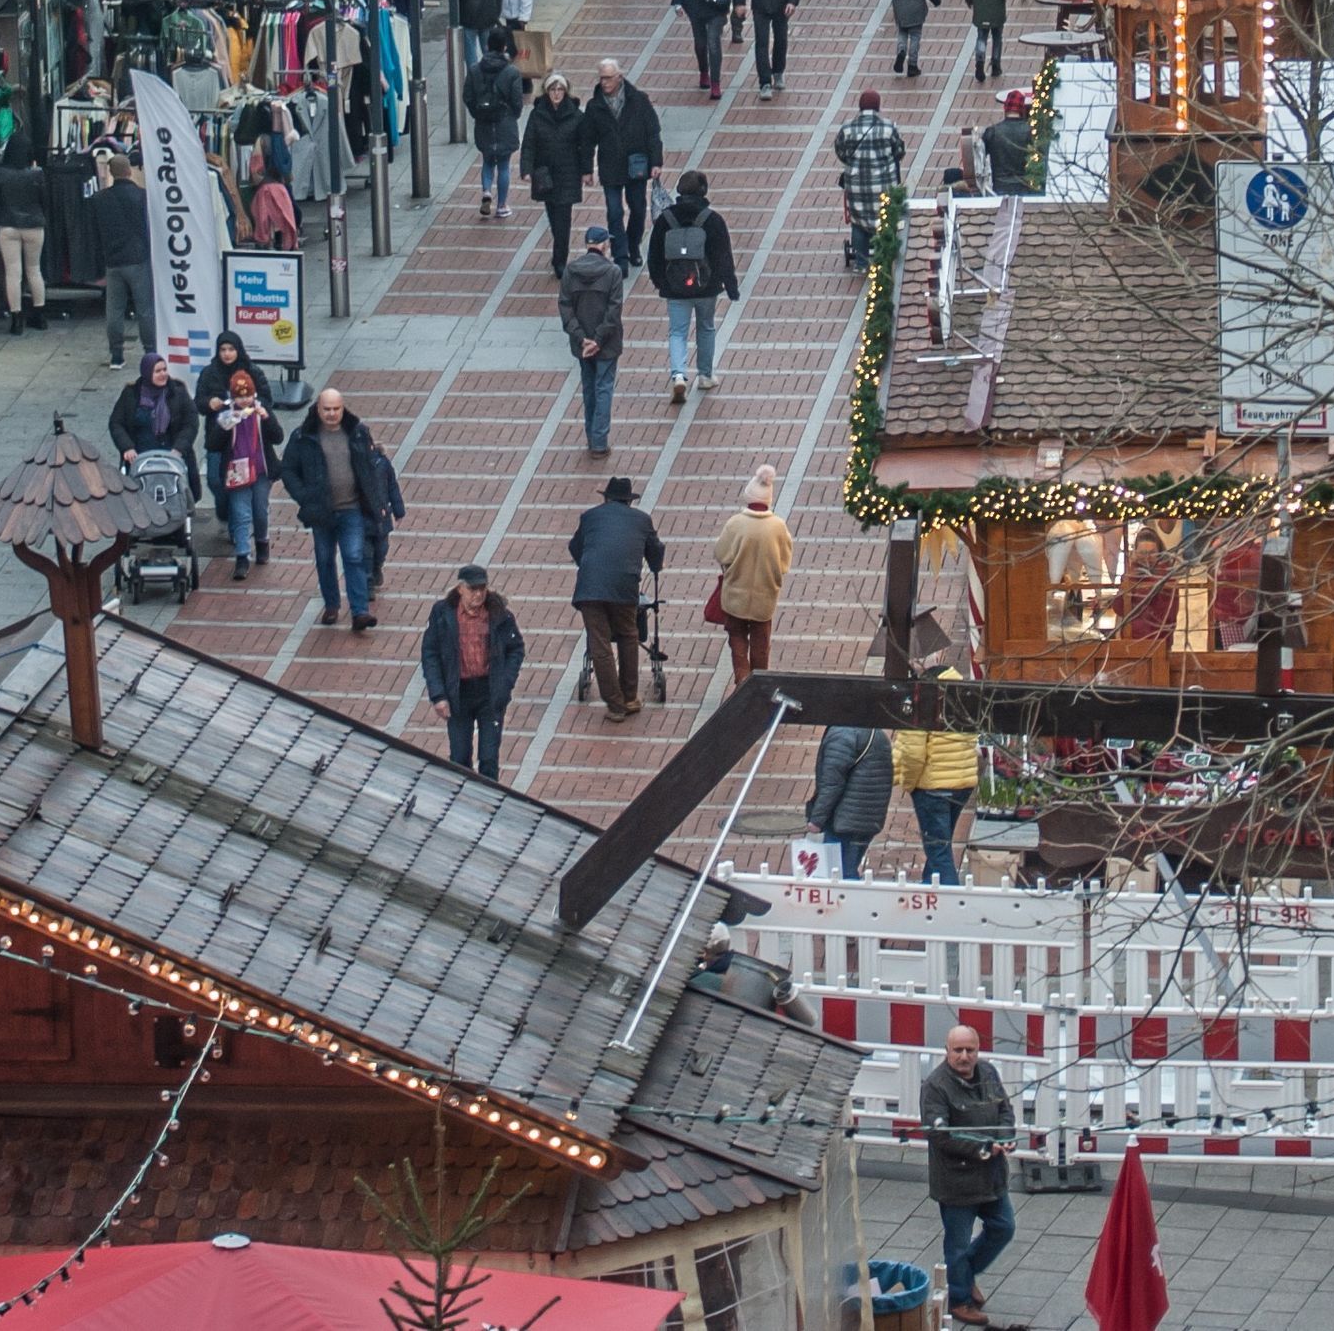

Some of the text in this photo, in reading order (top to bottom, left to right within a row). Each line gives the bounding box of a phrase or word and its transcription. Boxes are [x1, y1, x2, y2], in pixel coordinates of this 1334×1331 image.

[1262, 233, 1295, 249] ZONE
[237, 274, 264, 285] Mehr
[243, 292, 287, 304] Rabatte
[237, 309, 278, 321] für alle!
[795, 887, 938, 911] TBL SR
